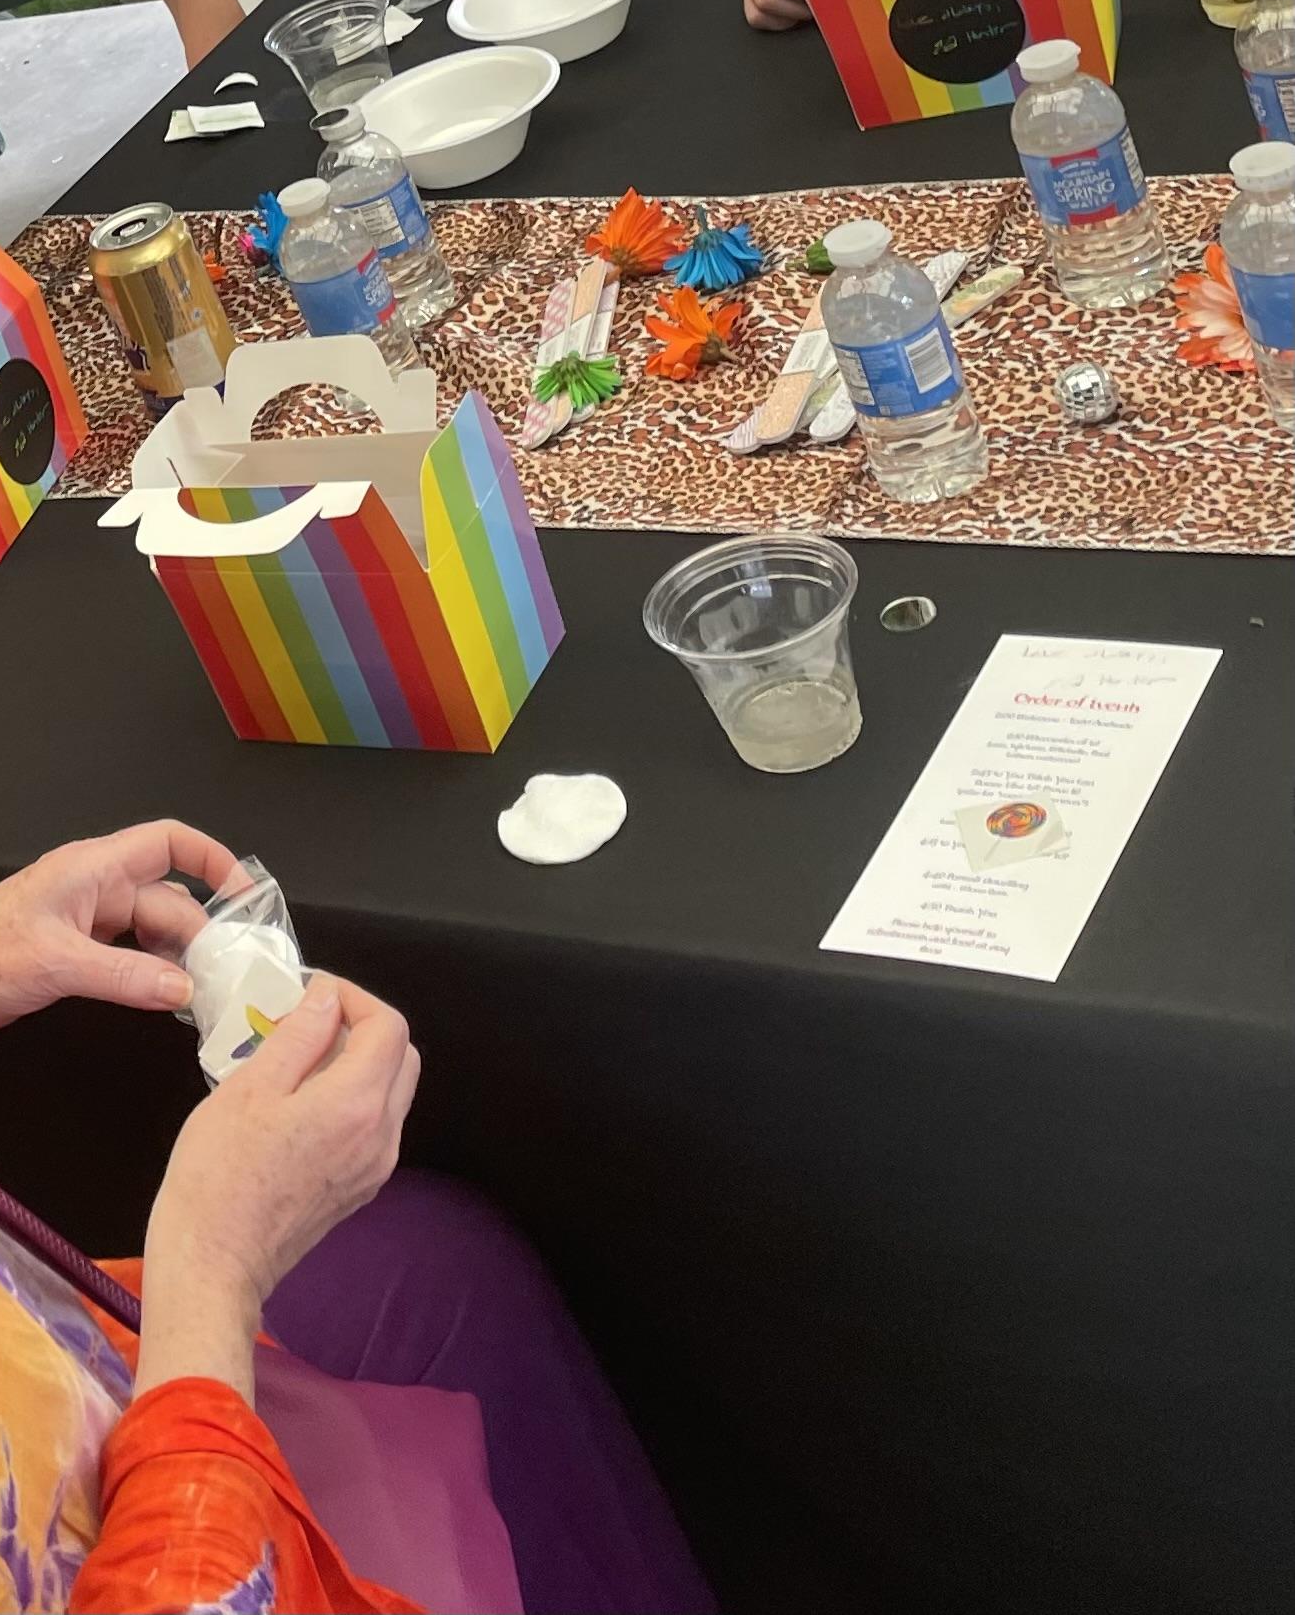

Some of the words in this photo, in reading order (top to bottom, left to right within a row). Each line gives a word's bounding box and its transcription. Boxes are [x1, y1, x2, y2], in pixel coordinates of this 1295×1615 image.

[1055, 178, 1115, 203] SPRING
[1014, 692, 1062, 706] Order
[1066, 694, 1086, 709] of
